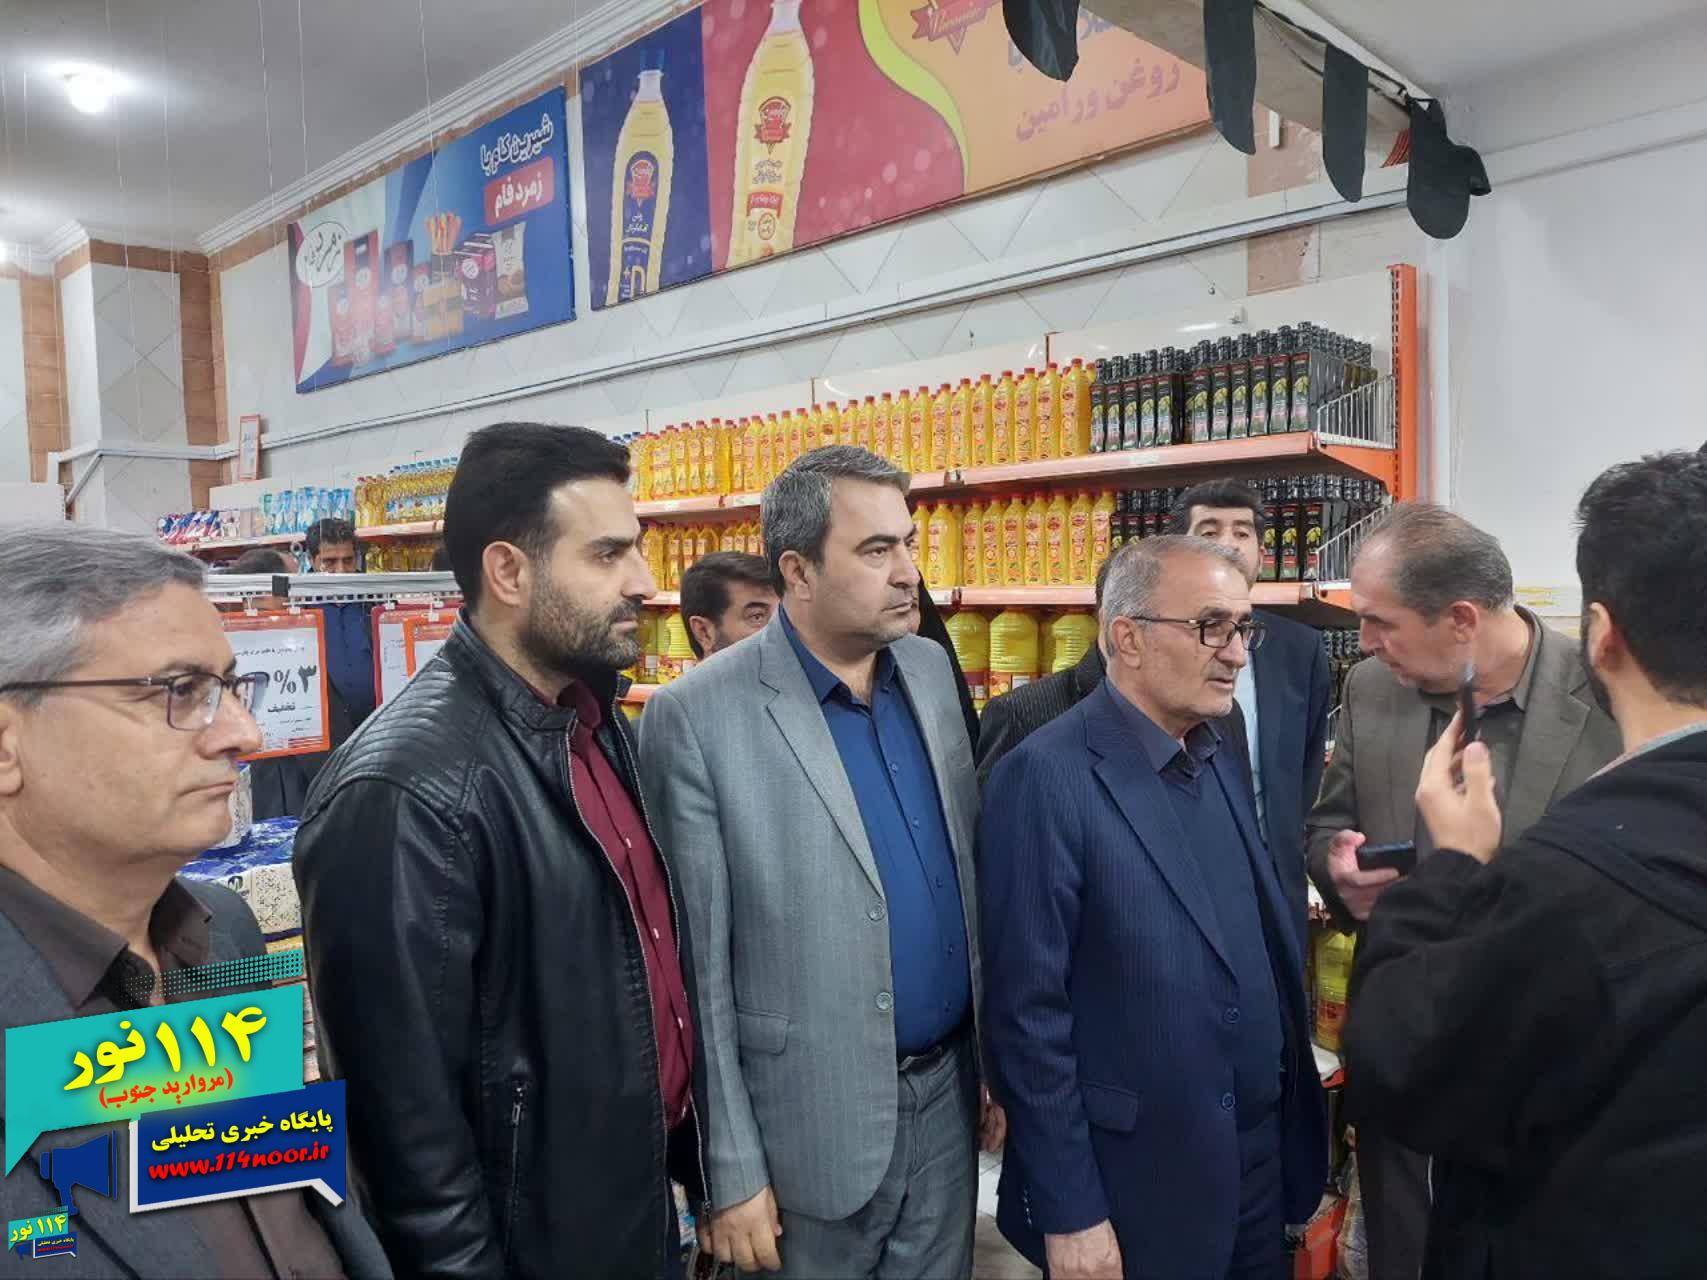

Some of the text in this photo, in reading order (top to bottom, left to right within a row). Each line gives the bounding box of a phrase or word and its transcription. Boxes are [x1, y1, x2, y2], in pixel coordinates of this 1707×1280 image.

[1016, 58, 1180, 142] روغن ورامین
[494, 176, 514, 219] فام
